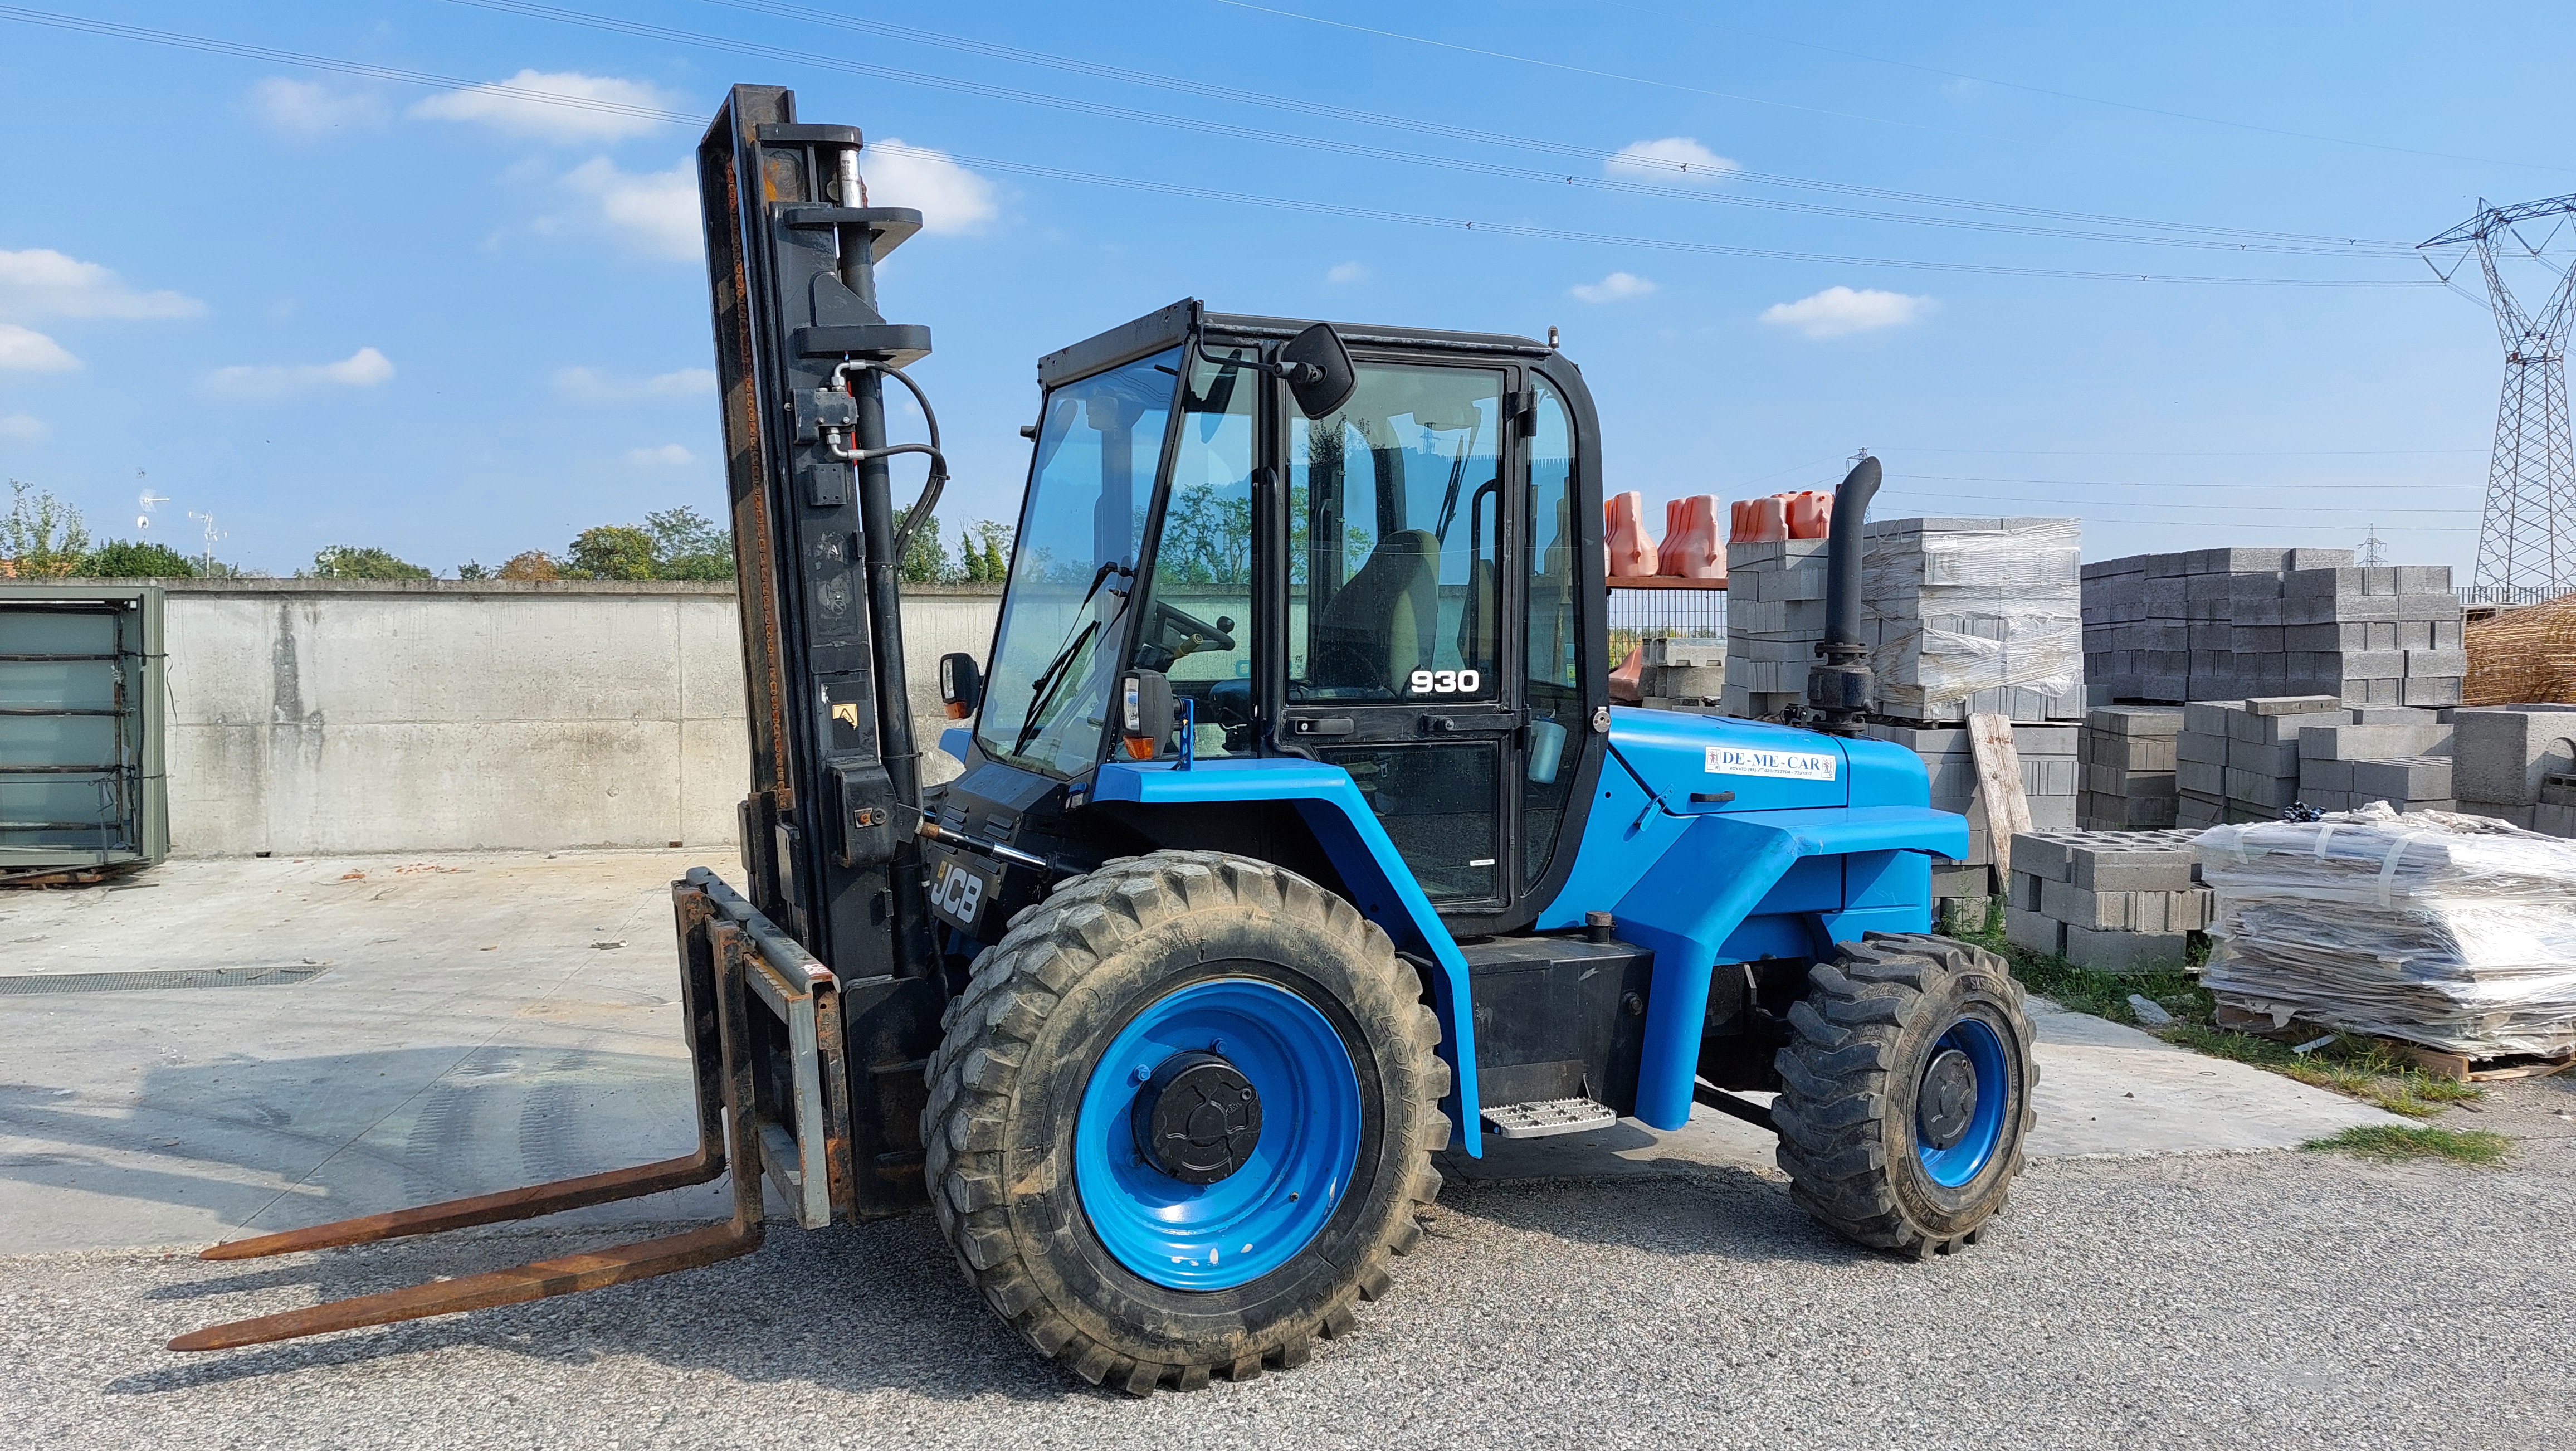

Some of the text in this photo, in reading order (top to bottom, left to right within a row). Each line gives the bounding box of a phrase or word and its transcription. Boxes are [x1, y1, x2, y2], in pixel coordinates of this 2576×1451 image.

[1411, 670, 1479, 693] 930
[930, 863, 983, 923] JCB
[1969, 976, 1987, 991] SKS
